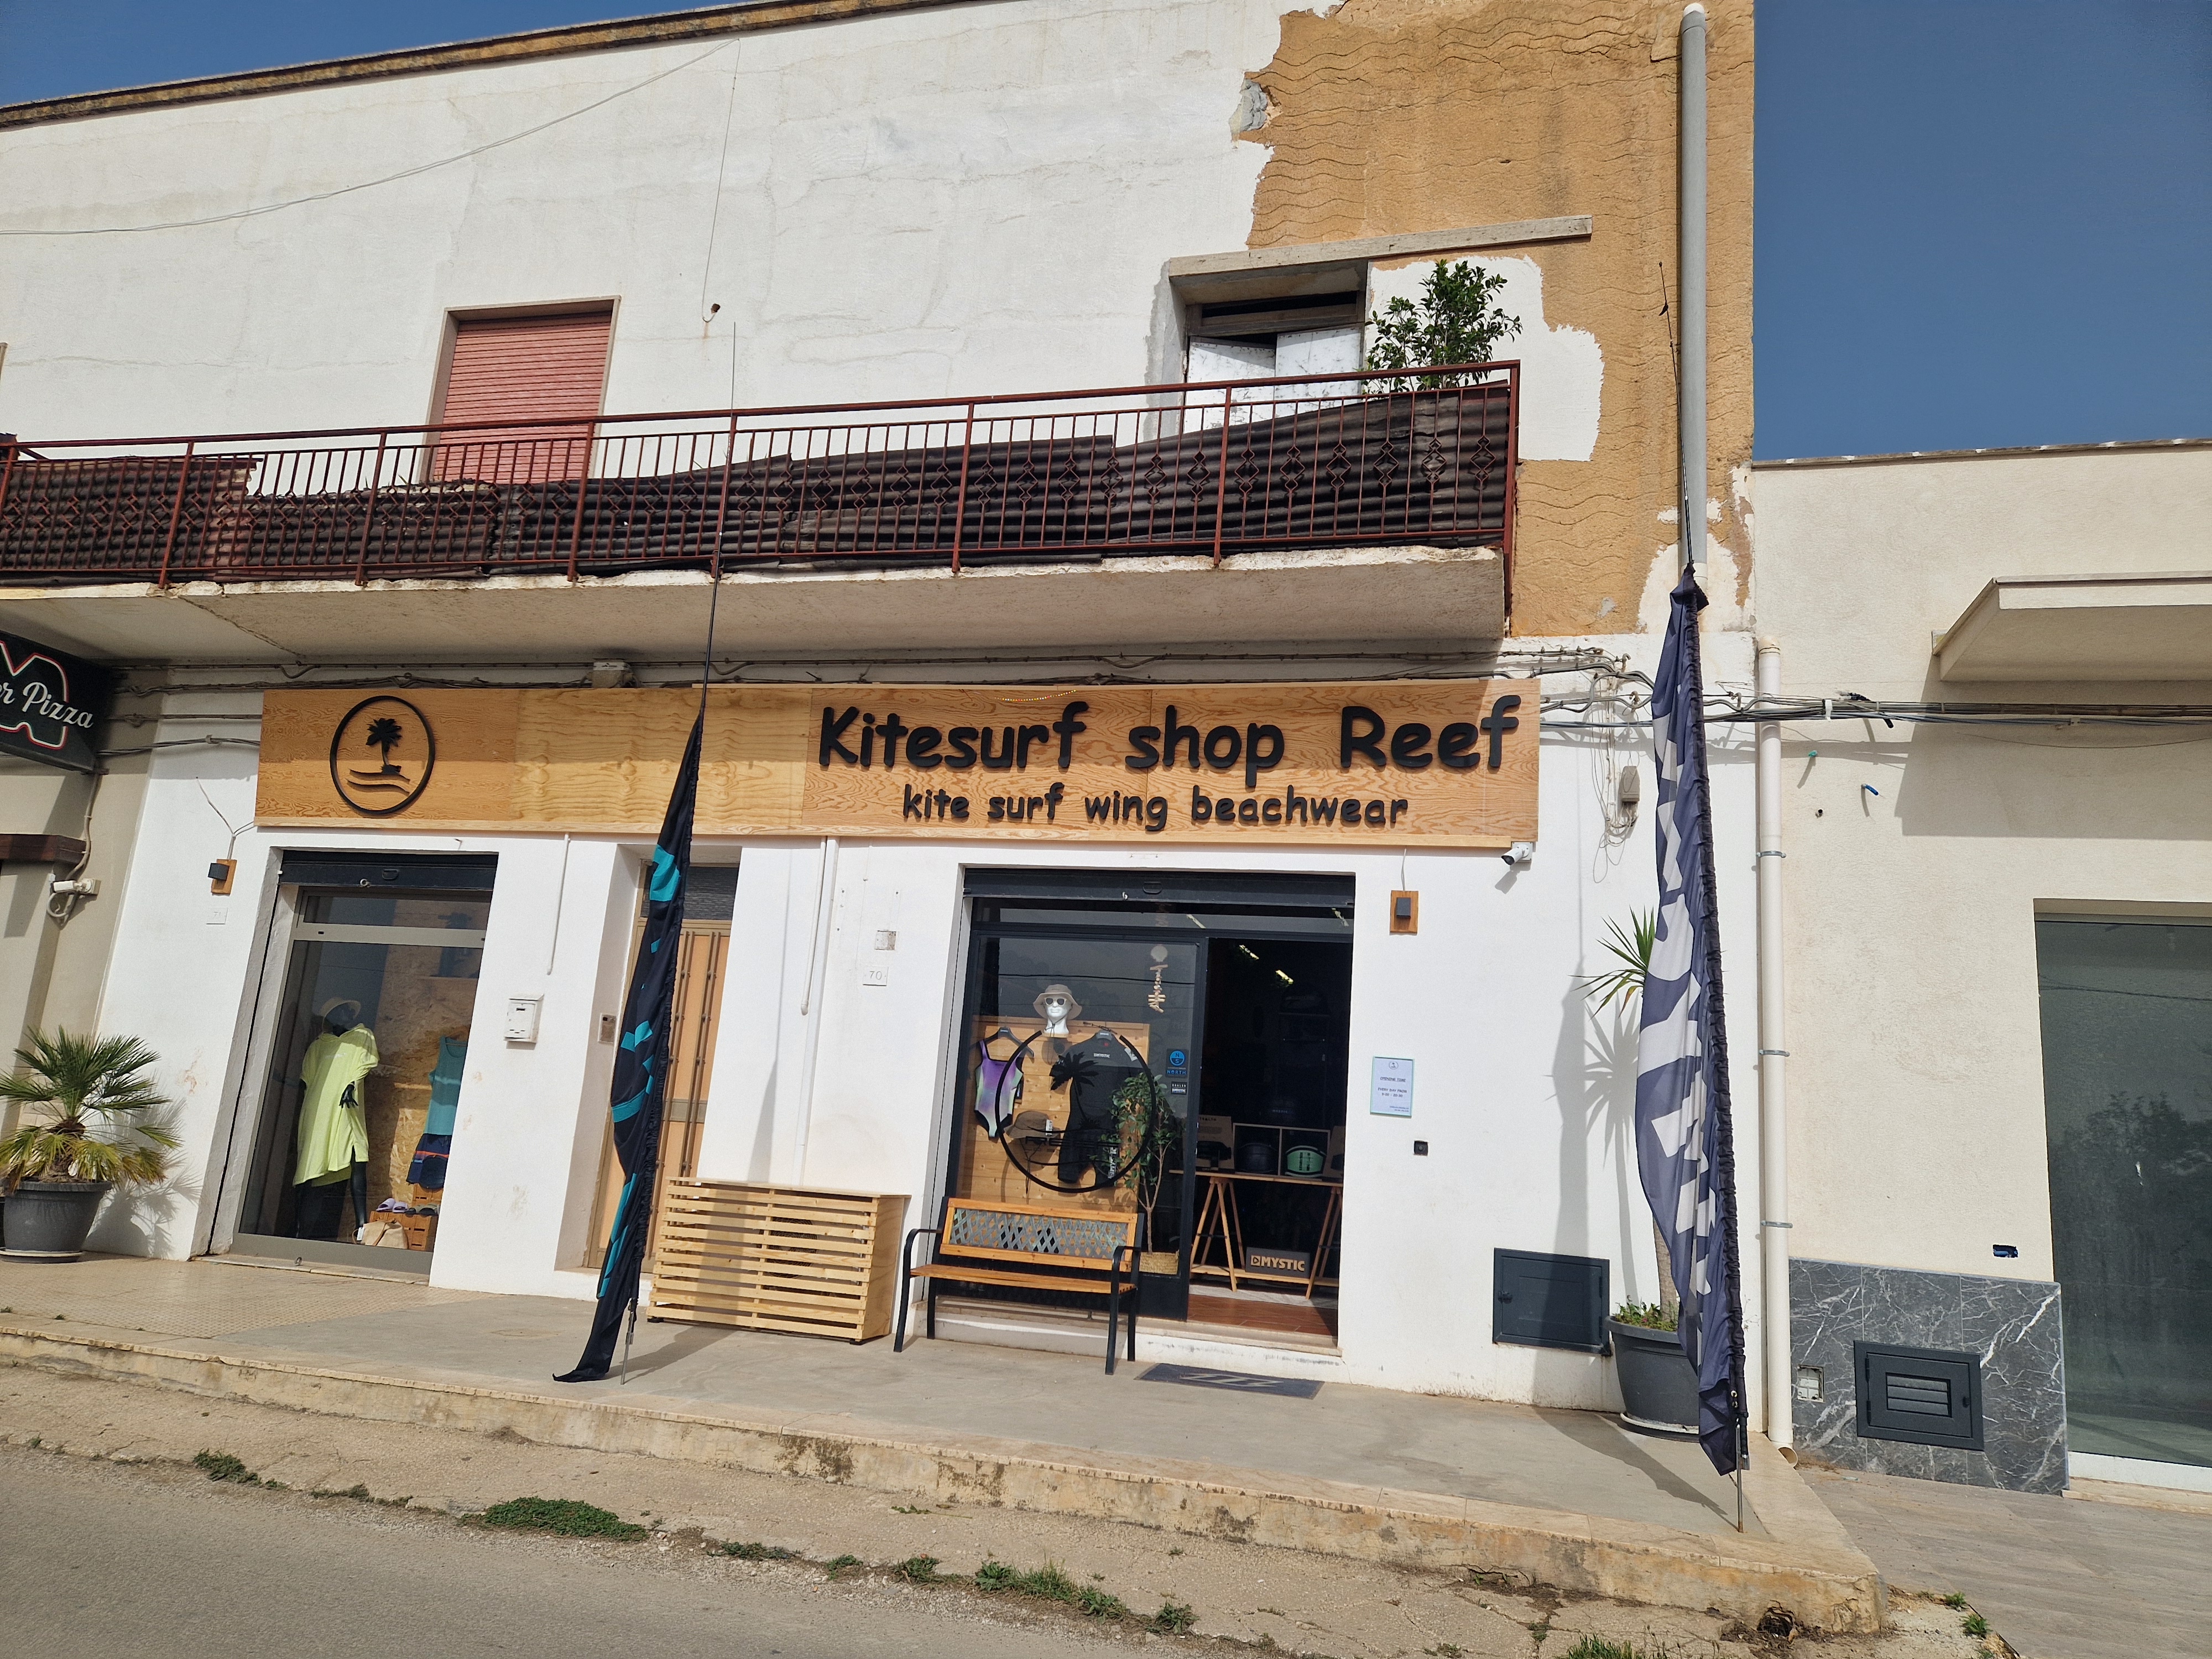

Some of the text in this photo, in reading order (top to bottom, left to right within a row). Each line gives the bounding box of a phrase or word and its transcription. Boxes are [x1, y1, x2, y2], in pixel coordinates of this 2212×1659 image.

[22, 682, 94, 728] Pizza
[819, 695, 1521, 789] Kitesurf shop Reef
[903, 782, 1408, 832] kite surf wing beachwear
[870, 971, 882, 980] 70
[1261, 1256, 1305, 1272] MYSTIC
